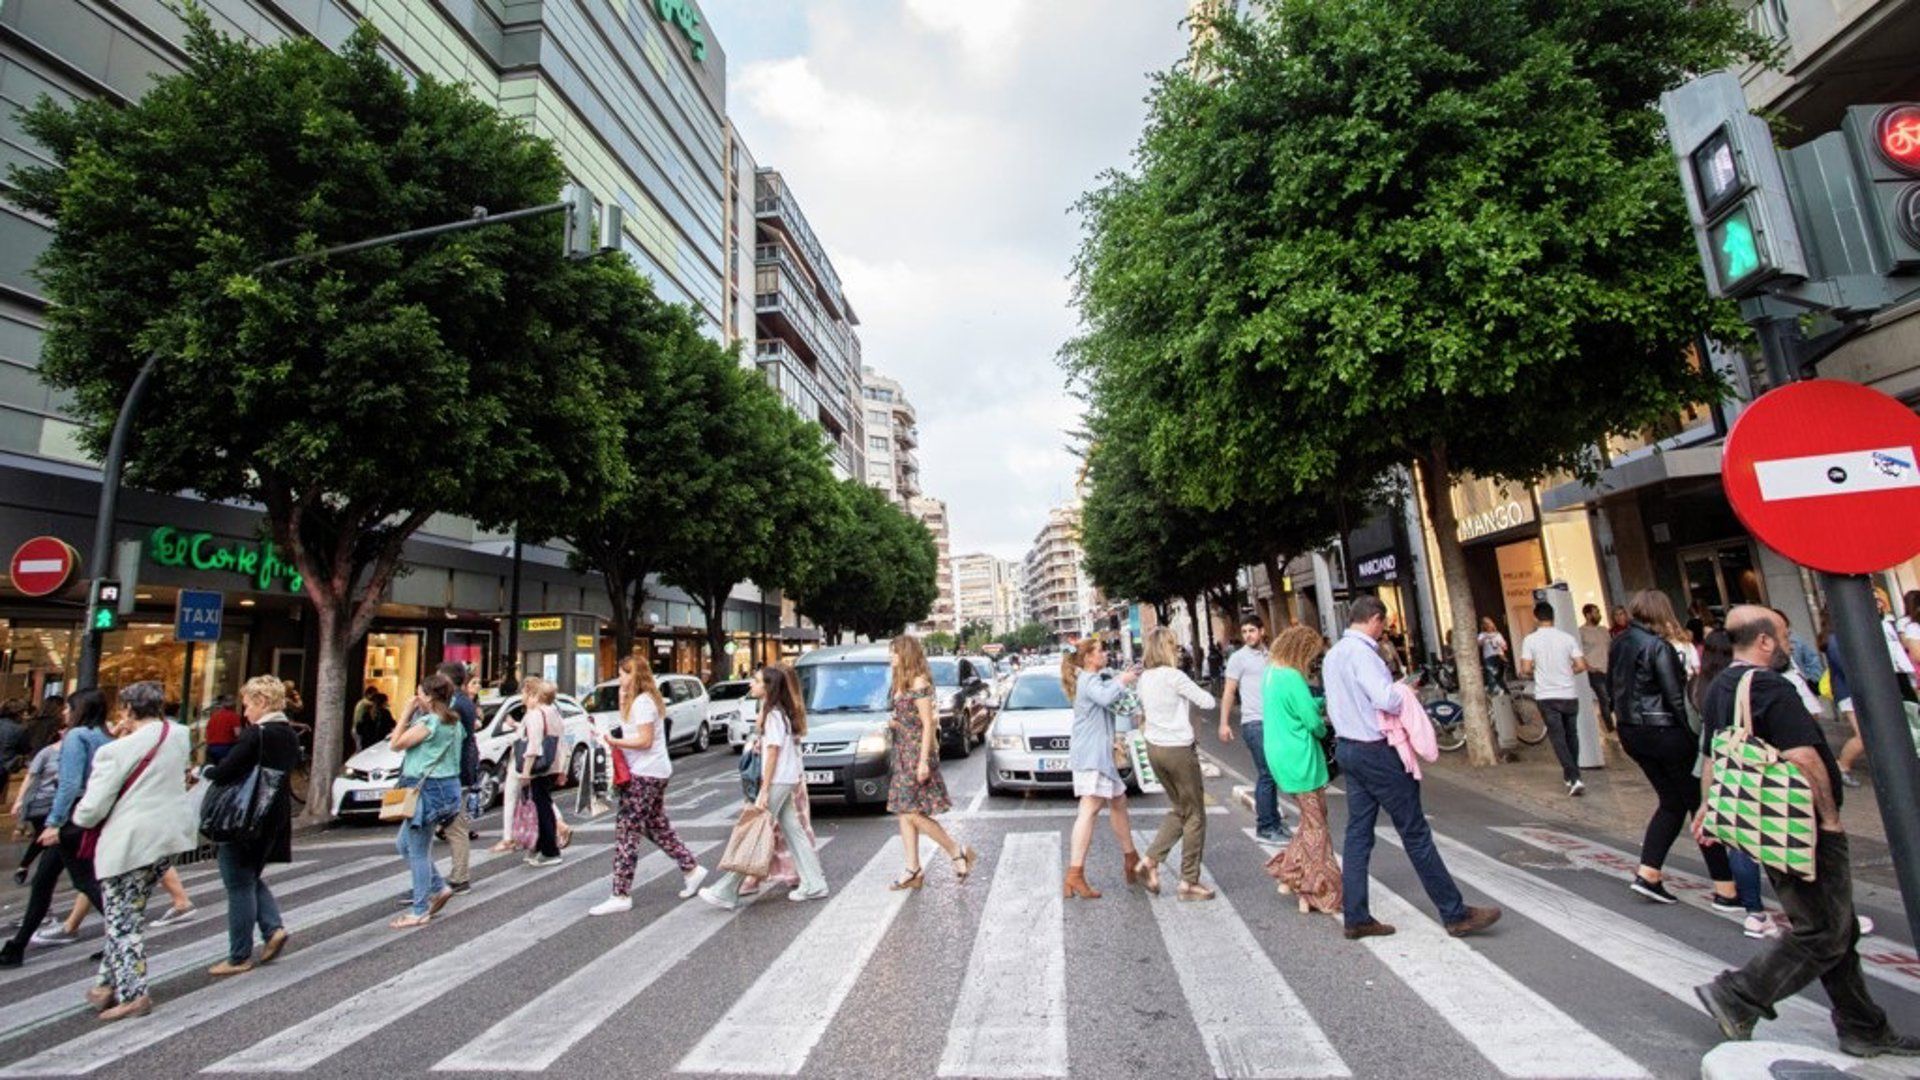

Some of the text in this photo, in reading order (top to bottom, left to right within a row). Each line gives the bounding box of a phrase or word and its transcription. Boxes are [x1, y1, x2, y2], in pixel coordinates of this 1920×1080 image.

[1457, 501, 1523, 542] MANGO
[152, 526, 187, 565] El
[191, 533, 258, 574] Corte
[1359, 554, 1396, 577] MARCIANO
[182, 607, 219, 624] TAXI
[532, 620, 559, 629] ONCE
